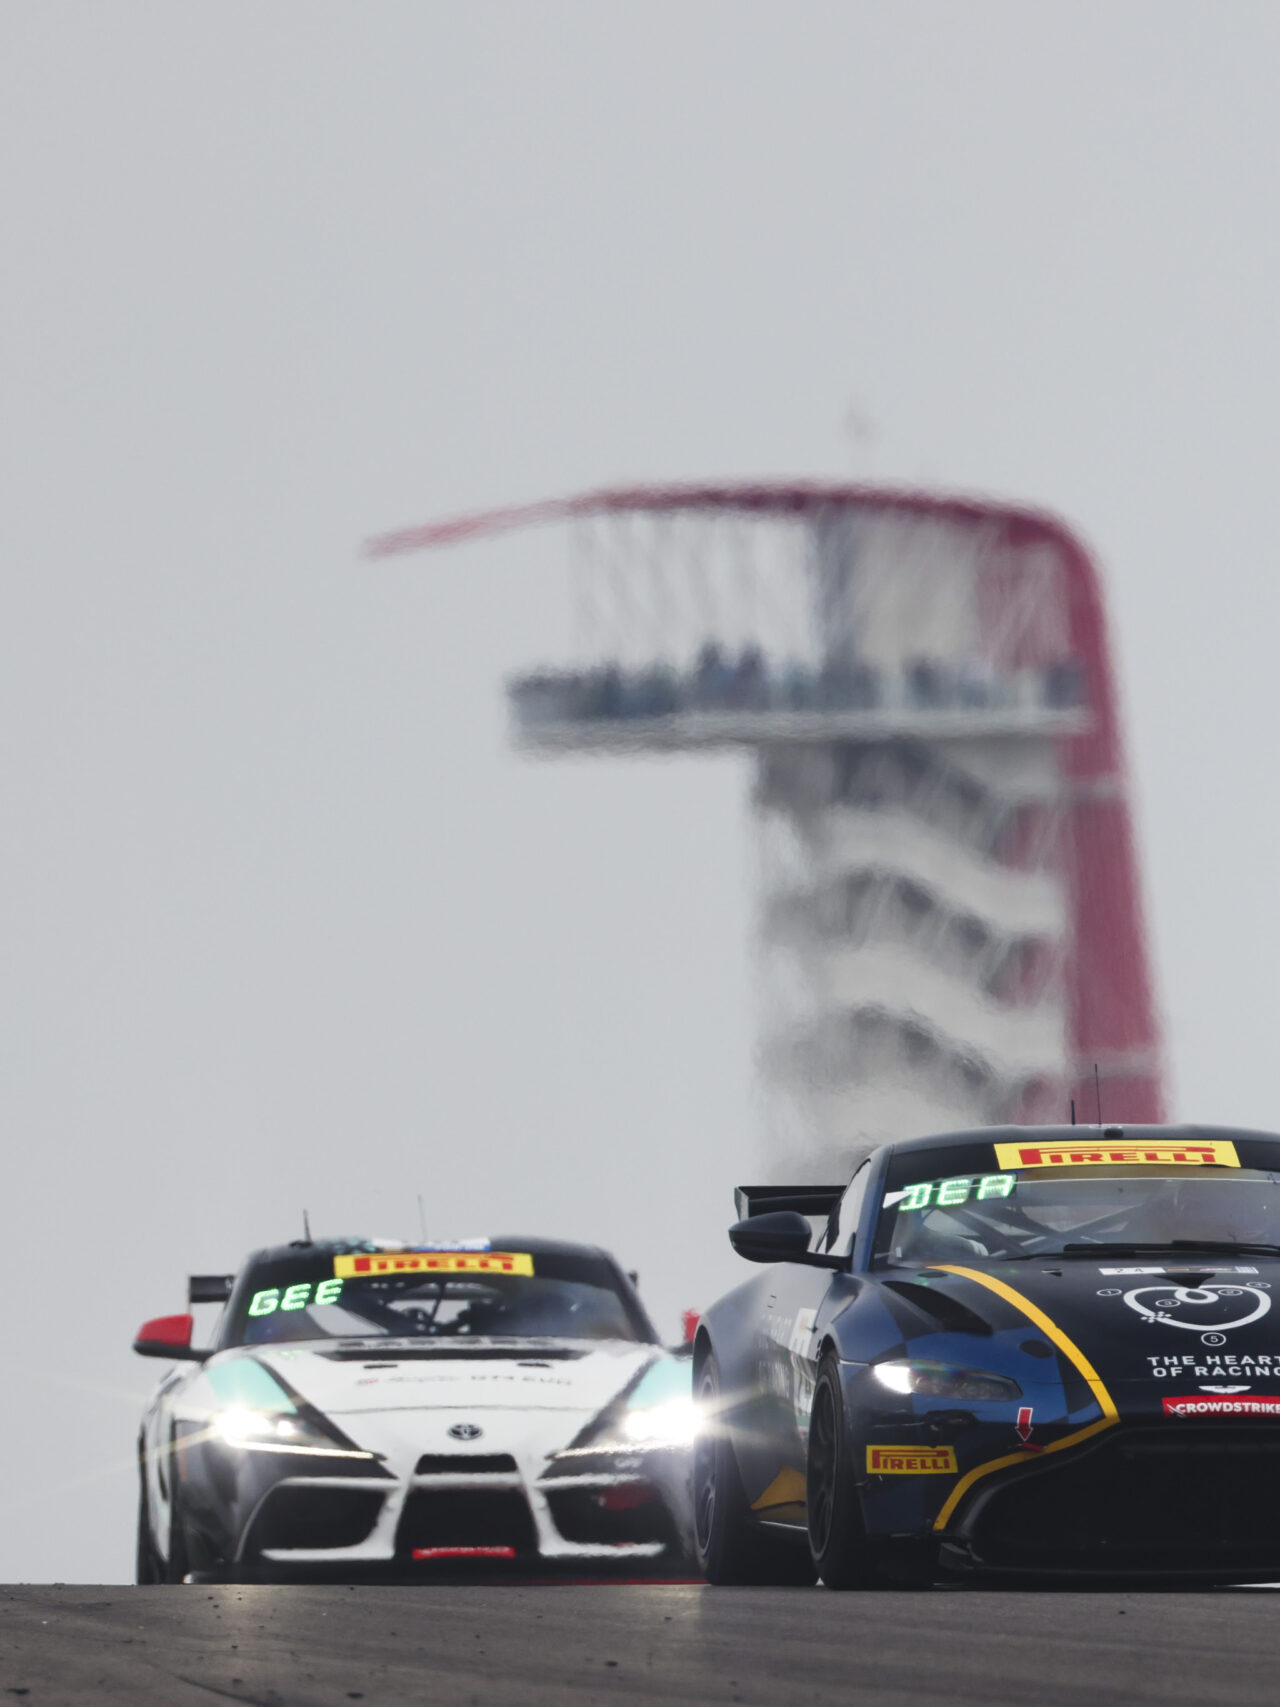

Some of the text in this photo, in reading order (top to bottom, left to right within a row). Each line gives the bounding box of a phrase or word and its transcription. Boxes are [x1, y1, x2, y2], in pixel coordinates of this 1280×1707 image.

[1018, 1145, 1216, 1165] PIRELLI
[248, 1278, 344, 1317] GEE
[1147, 1355, 1197, 1366] THE
[1153, 1366, 1183, 1377] OF
[871, 1449, 951, 1470] PIRELLI
